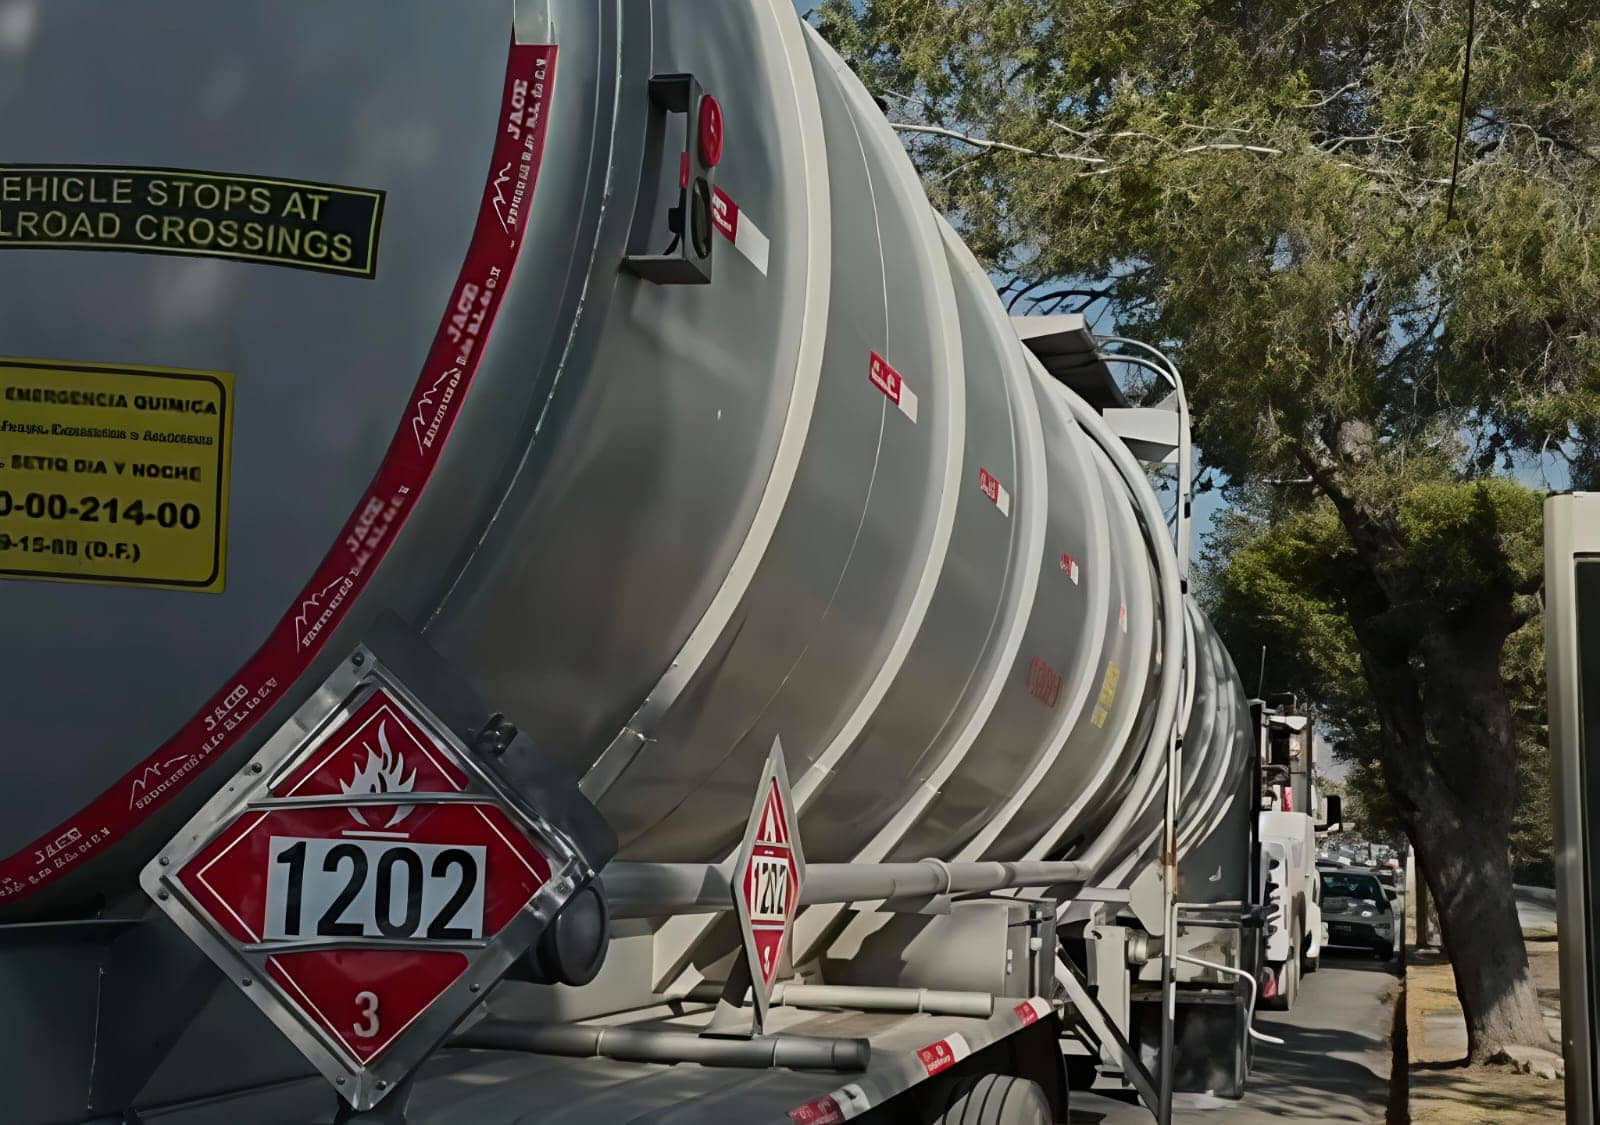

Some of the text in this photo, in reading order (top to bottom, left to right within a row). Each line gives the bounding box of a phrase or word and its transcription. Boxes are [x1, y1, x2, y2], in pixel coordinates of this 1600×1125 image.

[2, 176, 330, 221] EHICLE STOPS AT
[0, 209, 353, 263] LROAD CROSSINGS
[4, 386, 218, 415] EMERGENCIA QUIMICA
[74, 459, 107, 475] DIA
[113, 462, 126, 476] Y
[132, 463, 202, 482] NOCHE
[0, 489, 201, 530] 0-00-214-00
[276, 840, 478, 940] 1202
[352, 990, 381, 1039] 3
